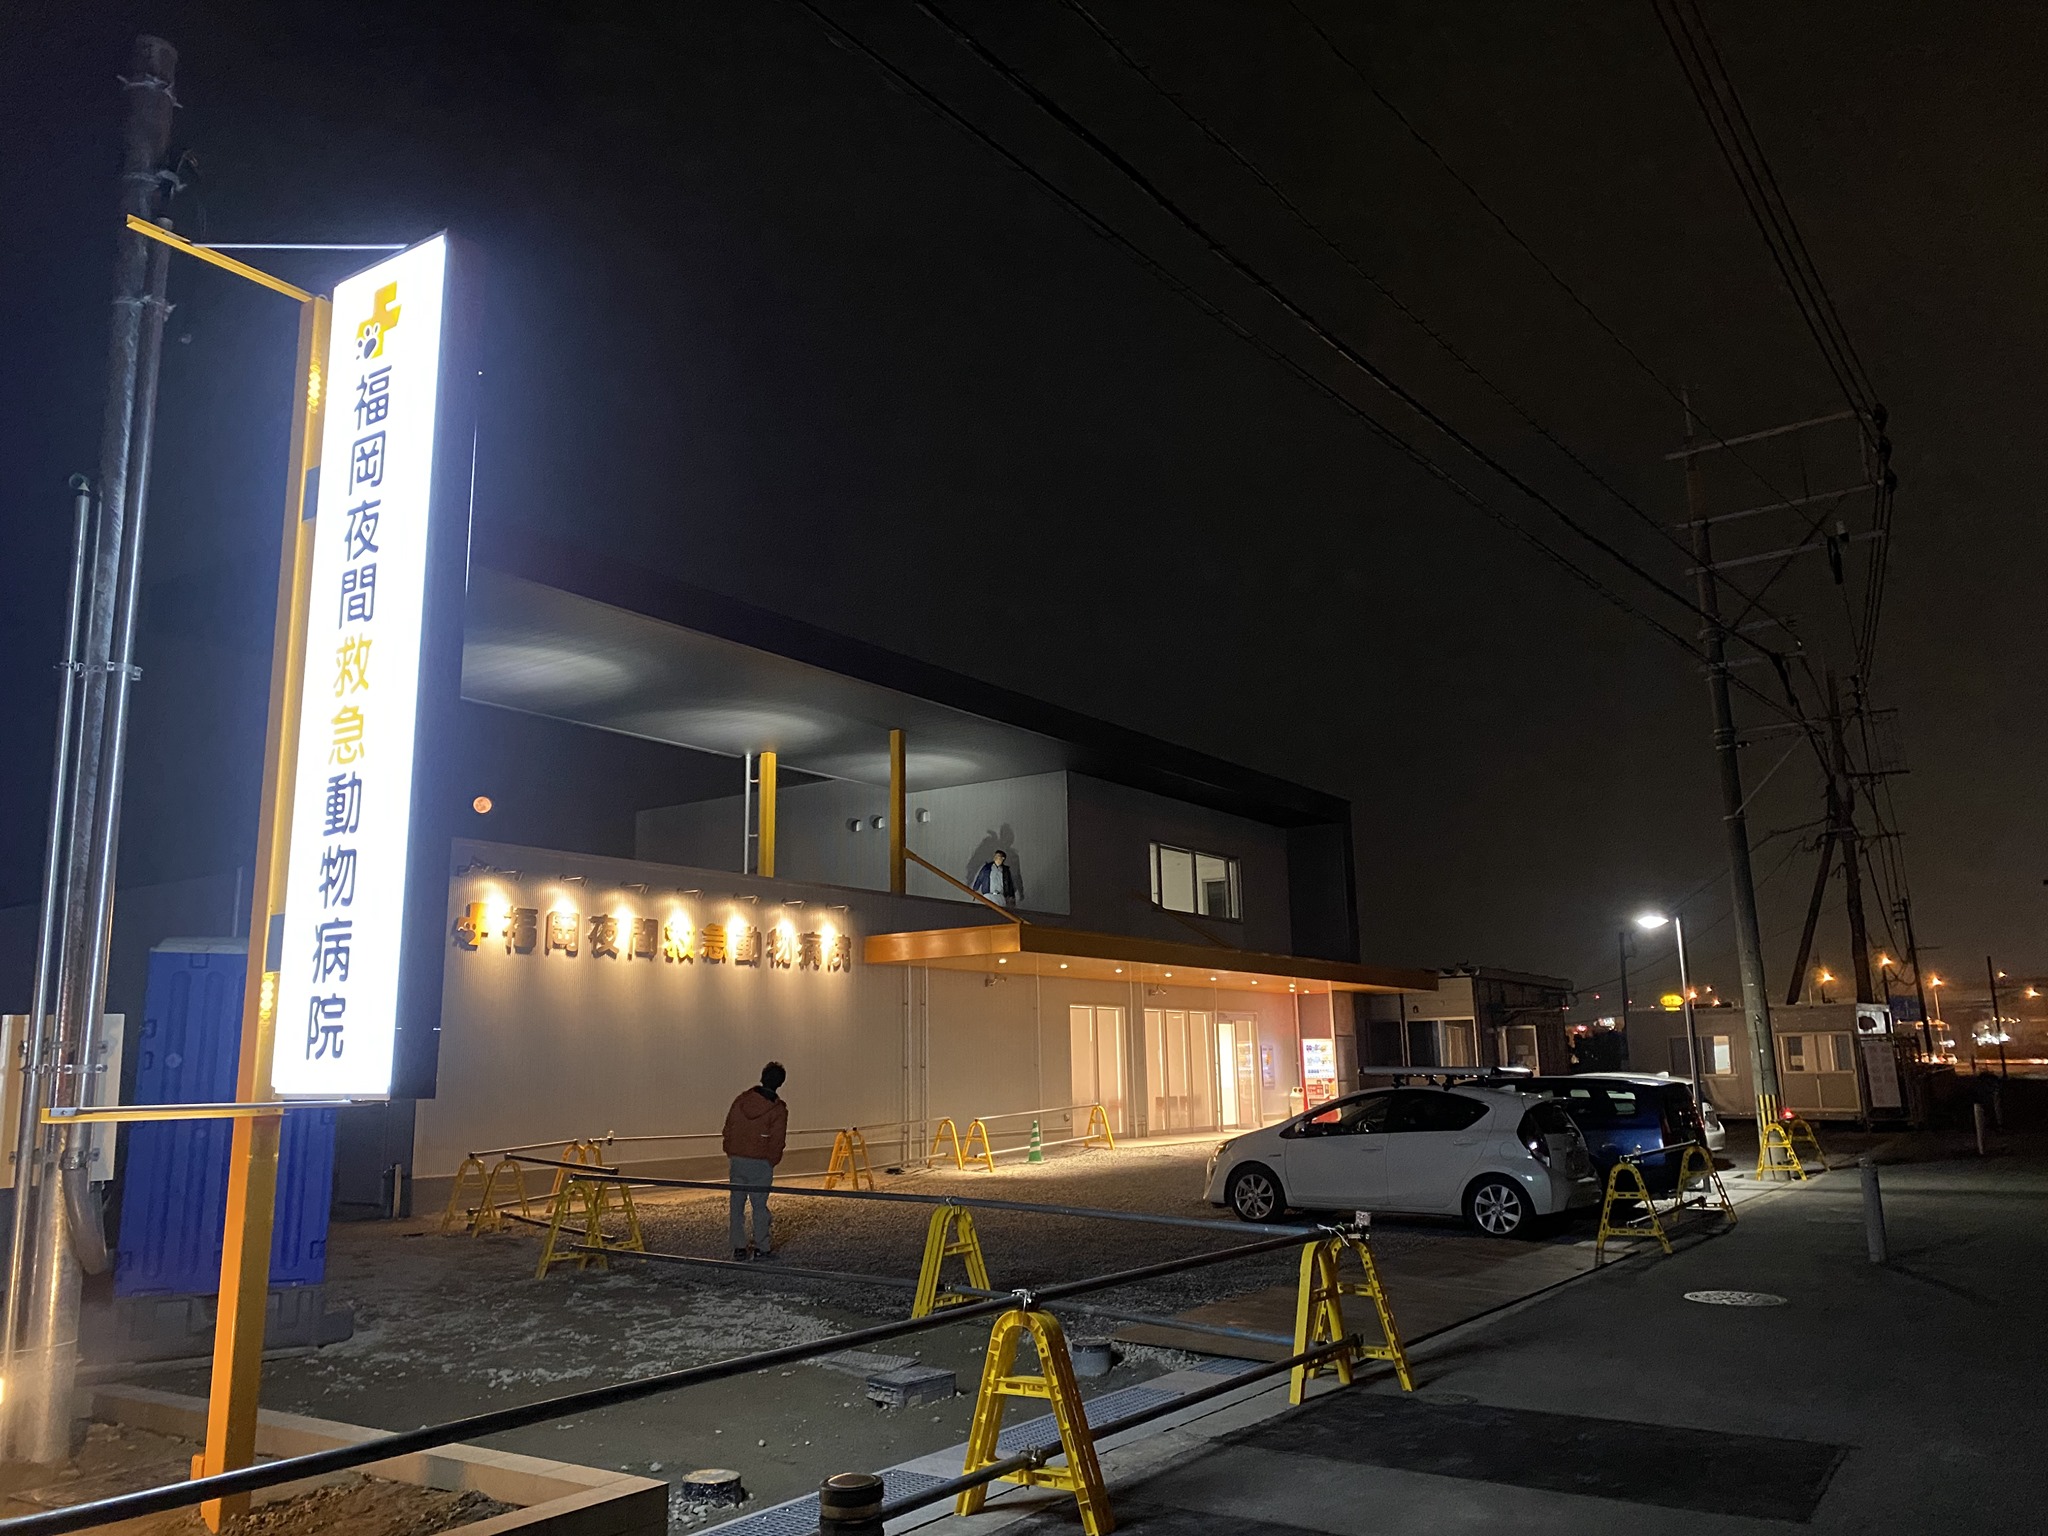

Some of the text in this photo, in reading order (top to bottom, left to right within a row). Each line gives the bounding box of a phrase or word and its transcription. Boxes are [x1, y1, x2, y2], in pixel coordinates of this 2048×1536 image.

[306, 364, 393, 1061] 福岡夜間救急動物病院
